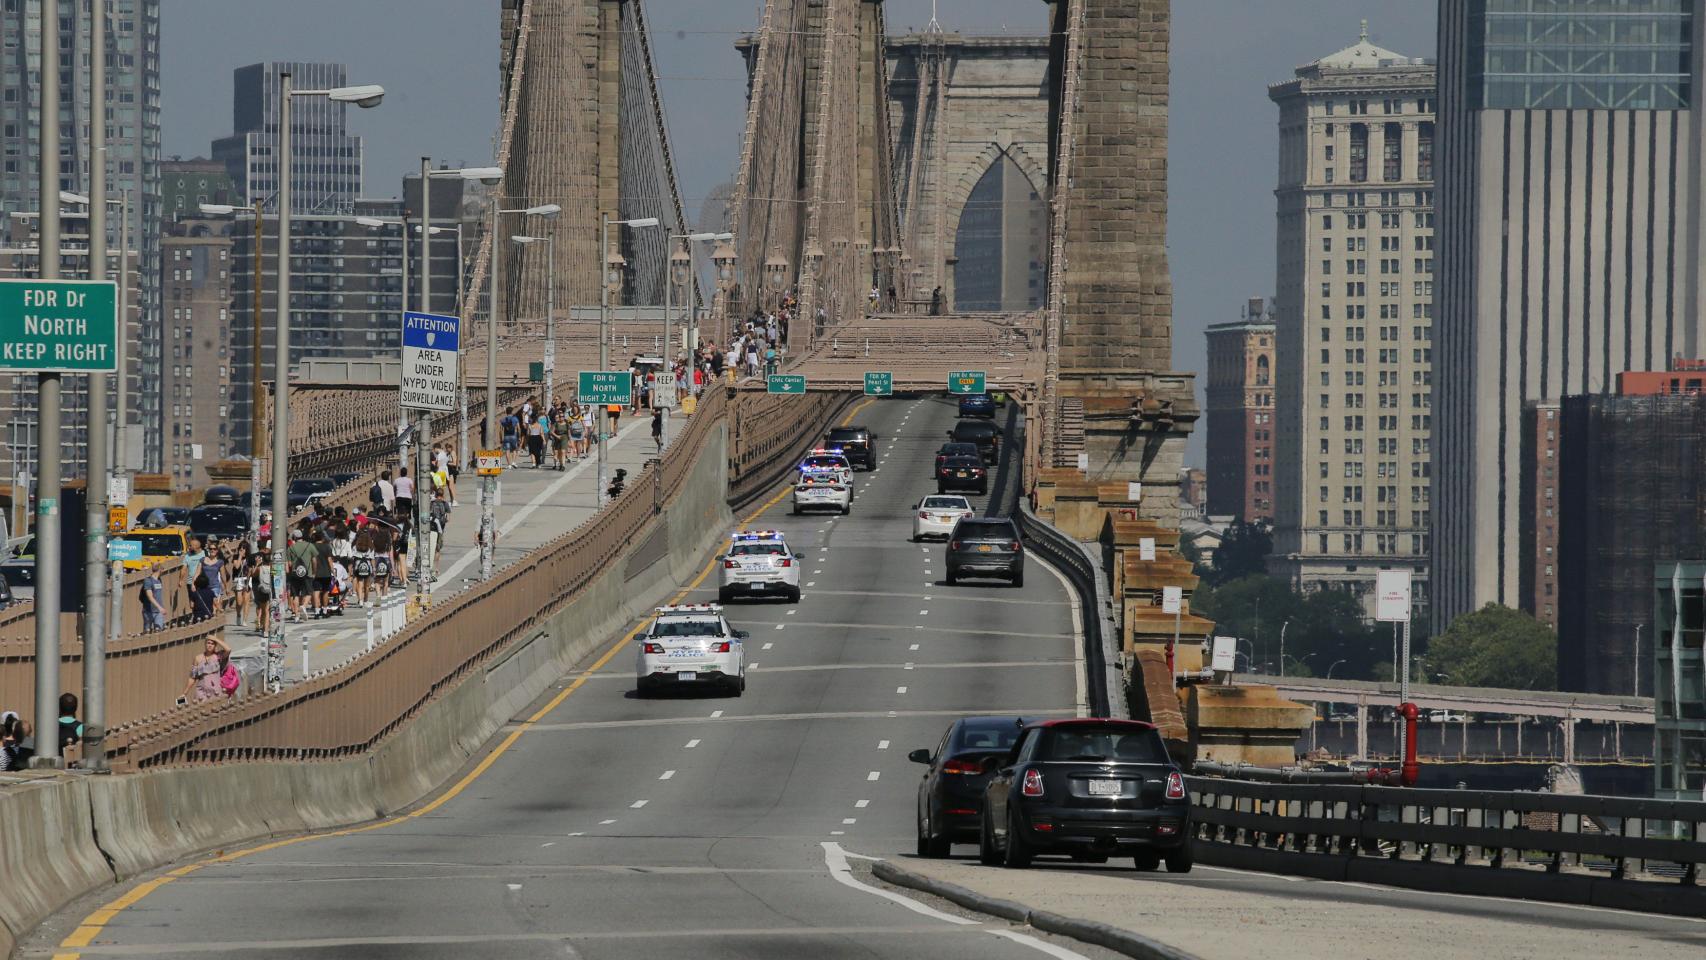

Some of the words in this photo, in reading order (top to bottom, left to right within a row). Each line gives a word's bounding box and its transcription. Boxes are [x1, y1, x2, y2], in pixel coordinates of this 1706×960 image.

[24, 289, 57, 307] FDR
[66, 290, 86, 307] Dr
[24, 315, 87, 335] NORTH
[407, 317, 456, 333] ATTENTION
[3, 342, 46, 360] KEEP
[55, 343, 108, 361] RIGHT
[417, 349, 442, 362] AREA
[415, 364, 444, 377] UNDER
[593, 374, 606, 382] FDR
[403, 377, 427, 390] NYPD
[430, 379, 455, 393] VIDEO
[656, 375, 674, 385] KEEP
[402, 391, 453, 406] SURVEILLANCE
[602, 393, 606, 402] 2
